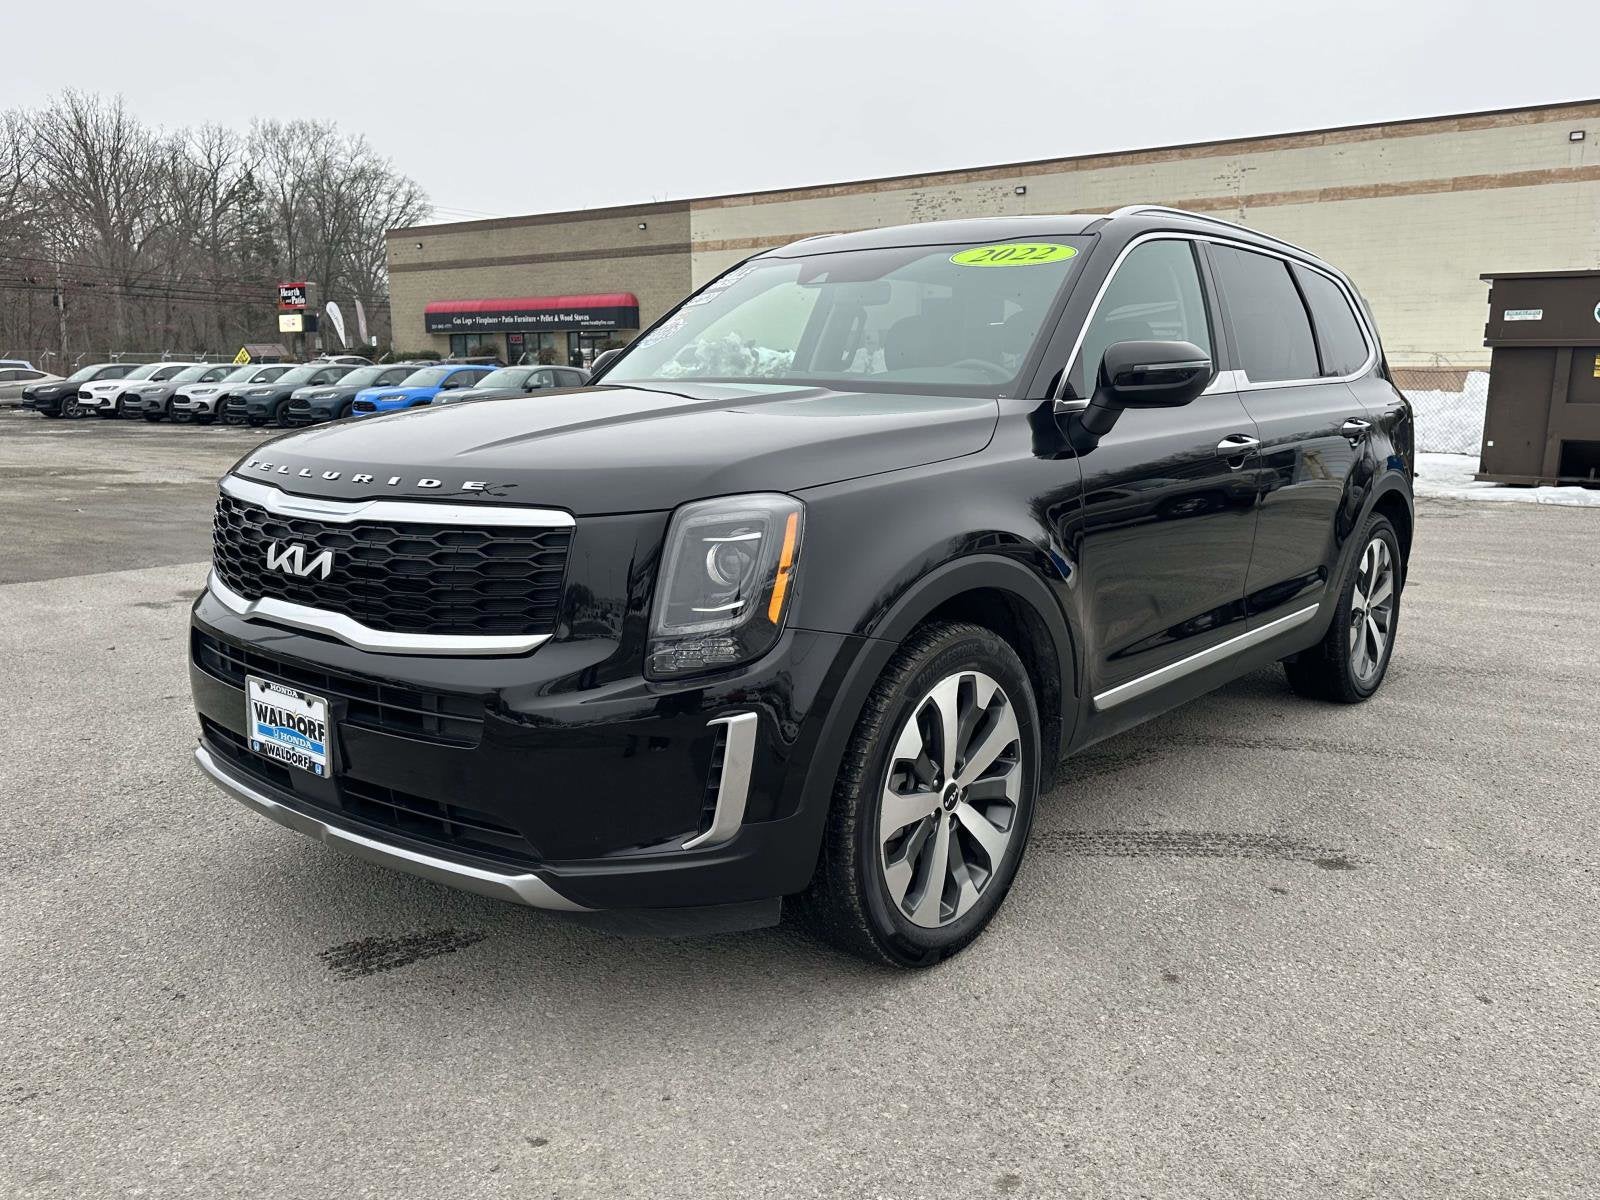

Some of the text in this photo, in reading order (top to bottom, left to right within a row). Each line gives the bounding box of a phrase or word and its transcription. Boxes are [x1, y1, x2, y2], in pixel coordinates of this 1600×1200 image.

[968, 246, 1057, 263] 2022
[280, 287, 300, 297] Hearth
[291, 295, 306, 305] Patio
[452, 316, 461, 325] Gas
[462, 316, 473, 326] Logs
[476, 315, 498, 326] Fireplaces
[501, 315, 514, 324] Patio
[514, 314, 537, 324] Furniture
[540, 313, 554, 323] Pellet
[559, 313, 573, 322] Wood
[573, 312, 590, 322] Stoves
[247, 460, 489, 491] TELLURIDE
[266, 540, 334, 581] KIA
[270, 683, 299, 698] HONDA
[253, 702, 326, 743] WALDORF
[280, 732, 313, 750] HONDA
[266, 741, 310, 769] WALDORF
